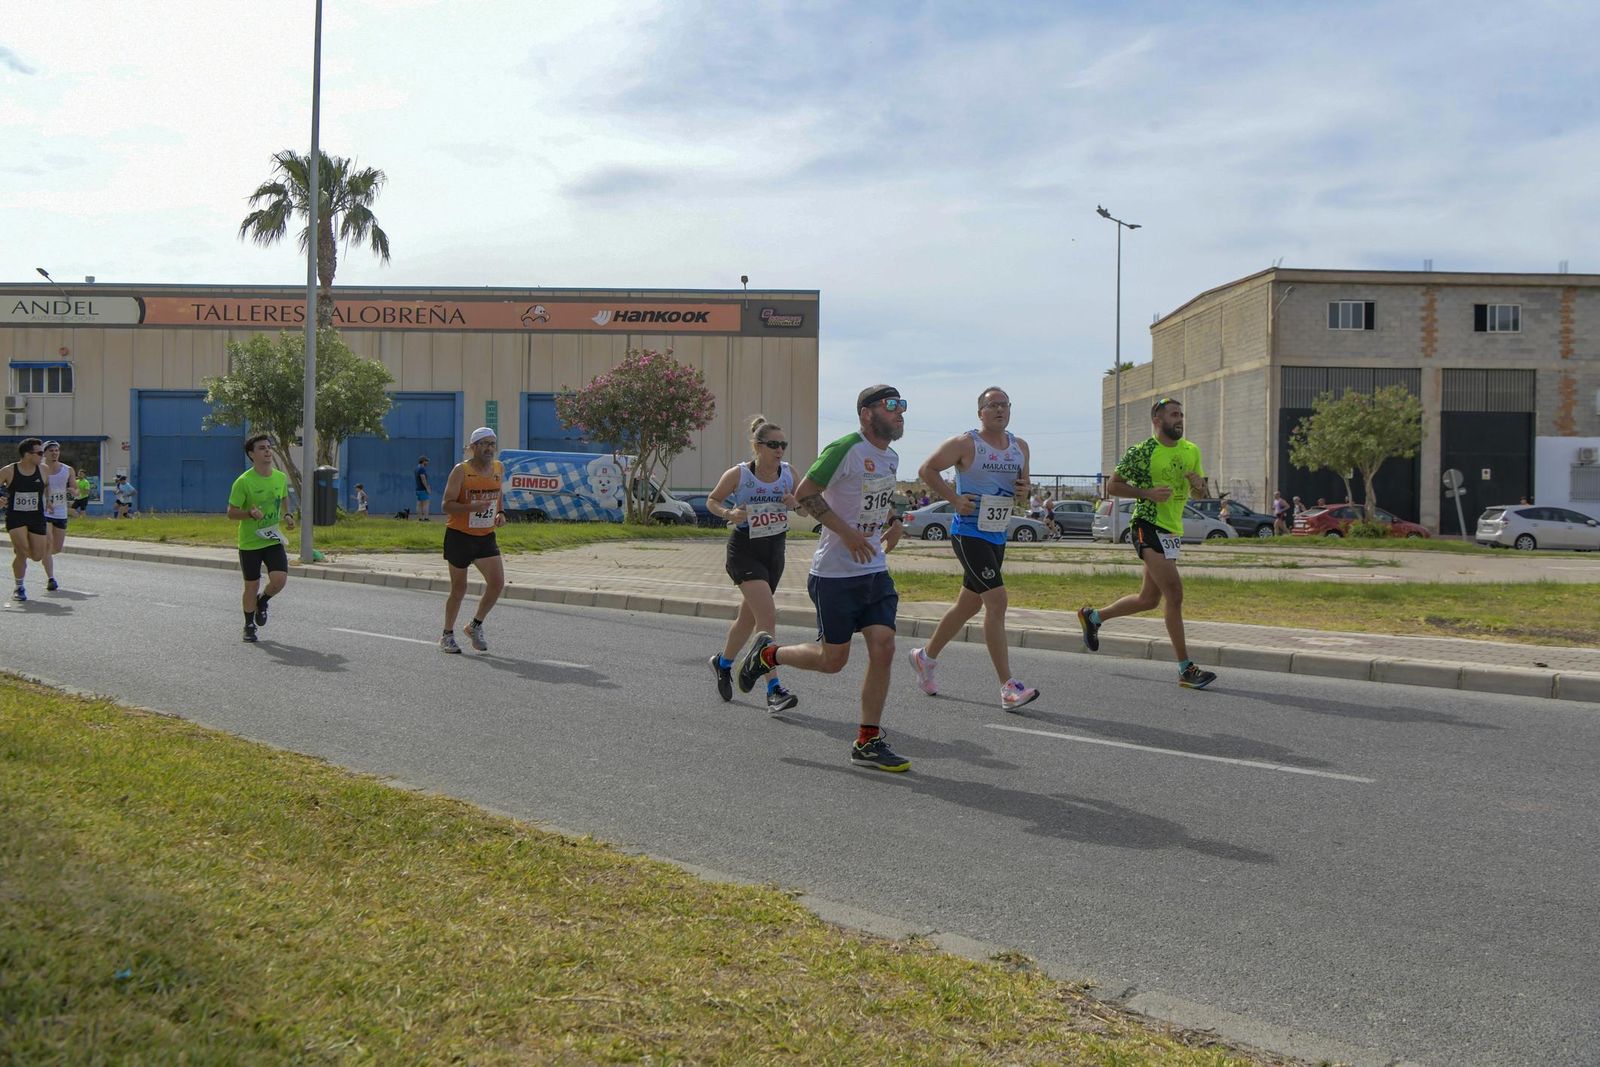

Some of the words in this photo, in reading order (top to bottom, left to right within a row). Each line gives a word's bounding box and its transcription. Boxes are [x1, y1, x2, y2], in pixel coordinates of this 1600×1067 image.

[12, 300, 99, 315] ANDEL
[191, 303, 305, 323] TALLERES
[331, 304, 466, 325] ALOBREÑA
[511, 477, 559, 490] BIMBO
[16, 497, 37, 506] 3016
[750, 512, 788, 528] 2056
[986, 507, 1009, 521] 337
